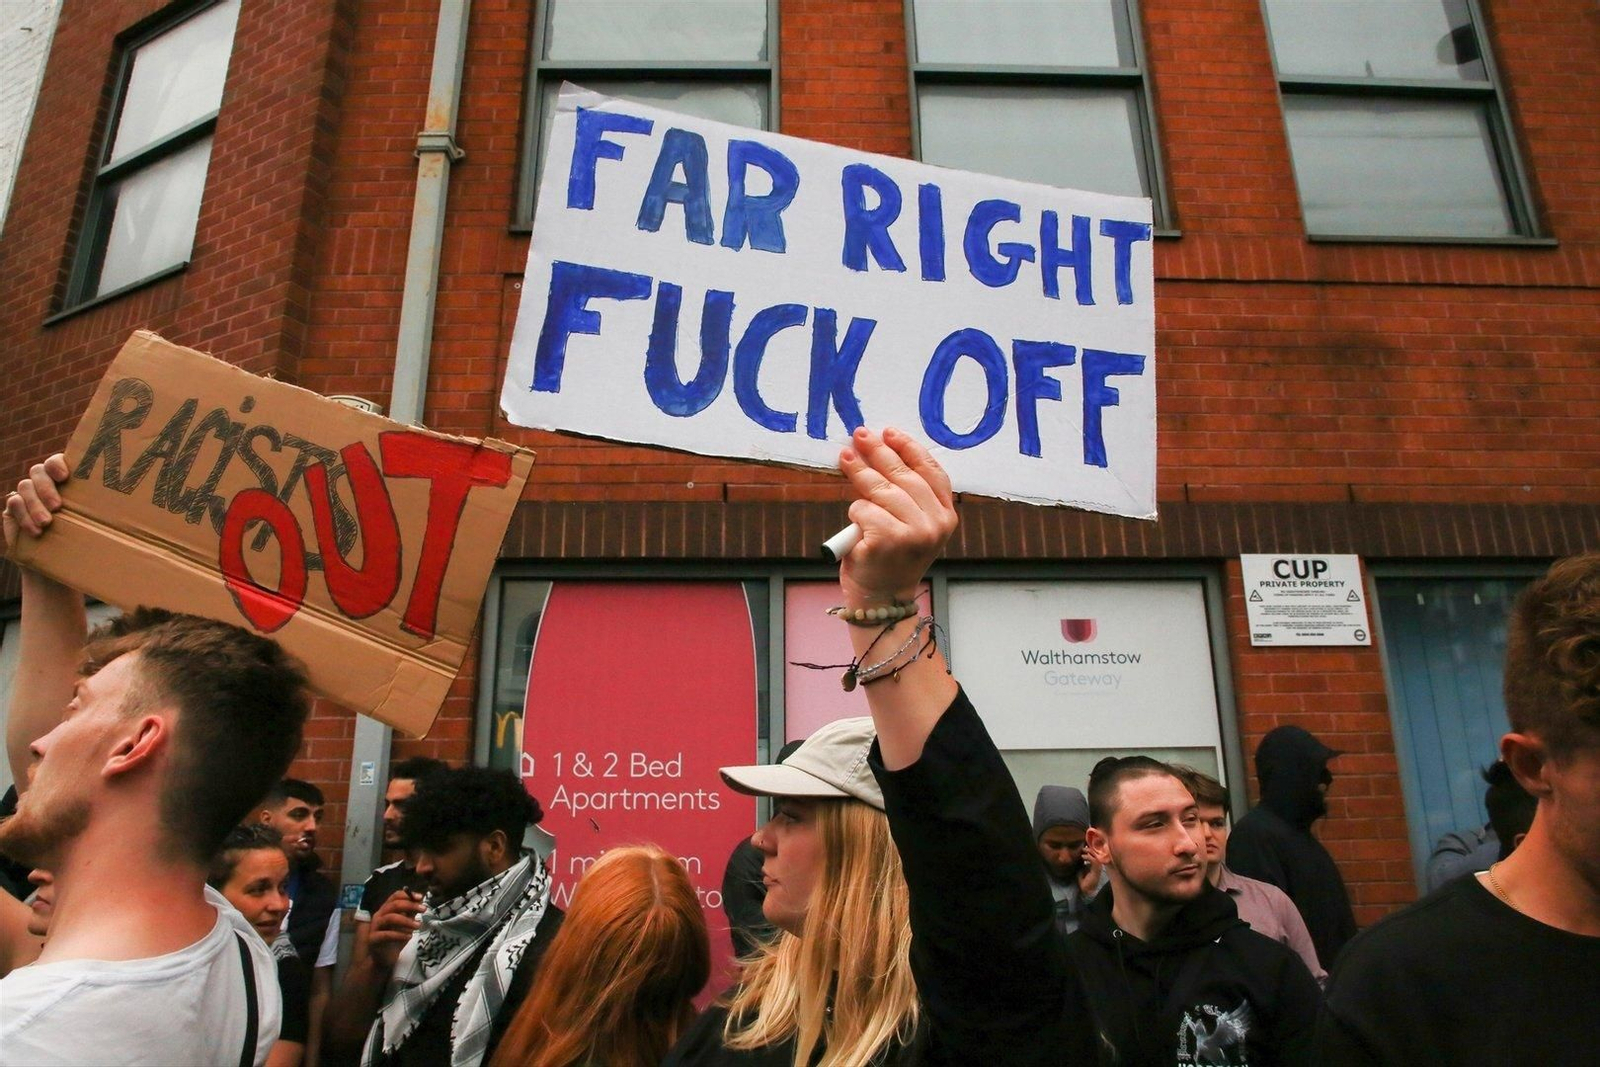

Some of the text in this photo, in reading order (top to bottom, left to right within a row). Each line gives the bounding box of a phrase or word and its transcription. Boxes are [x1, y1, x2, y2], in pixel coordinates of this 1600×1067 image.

[567, 106, 1151, 304] FAR RIGHT
[530, 260, 1146, 468] FUCK OFF
[219, 430, 513, 634] OUT
[1273, 559, 1328, 579] CUP
[1260, 580, 1345, 588] PRIVATE PROPERTY
[1021, 650, 1141, 665] Walthamstow
[1044, 670, 1122, 690] Gateway
[552, 752, 682, 777] 1 & 2 Bed
[550, 785, 720, 817] Apartments
